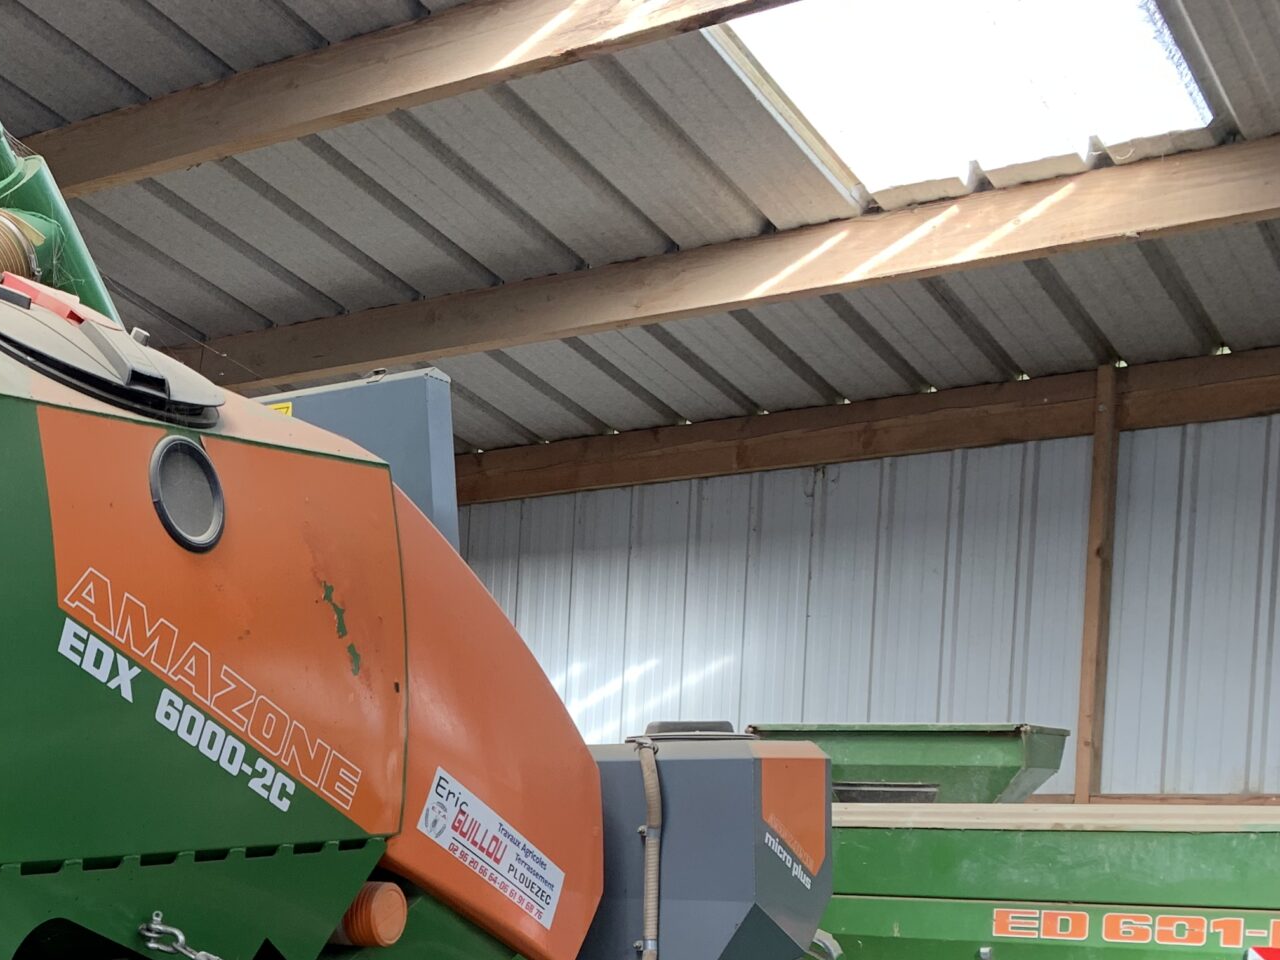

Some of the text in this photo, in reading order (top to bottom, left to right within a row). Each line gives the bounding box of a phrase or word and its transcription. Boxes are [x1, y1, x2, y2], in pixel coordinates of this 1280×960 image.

[63, 566, 362, 810] AMAZONE
[57, 616, 296, 812] EDX 6000-2C
[435, 775, 469, 814] Eric
[448, 842, 459, 855] 02
[468, 857, 479, 870] 20
[451, 810, 507, 865] GUILLOU
[498, 822, 548, 871] Travaux Agricoles
[764, 831, 793, 869] micro
[791, 862, 812, 890] plus
[507, 863, 552, 906] PLOUEZEC
[515, 852, 555, 891] Terrassement
[992, 908, 1280, 948] ED 601-
